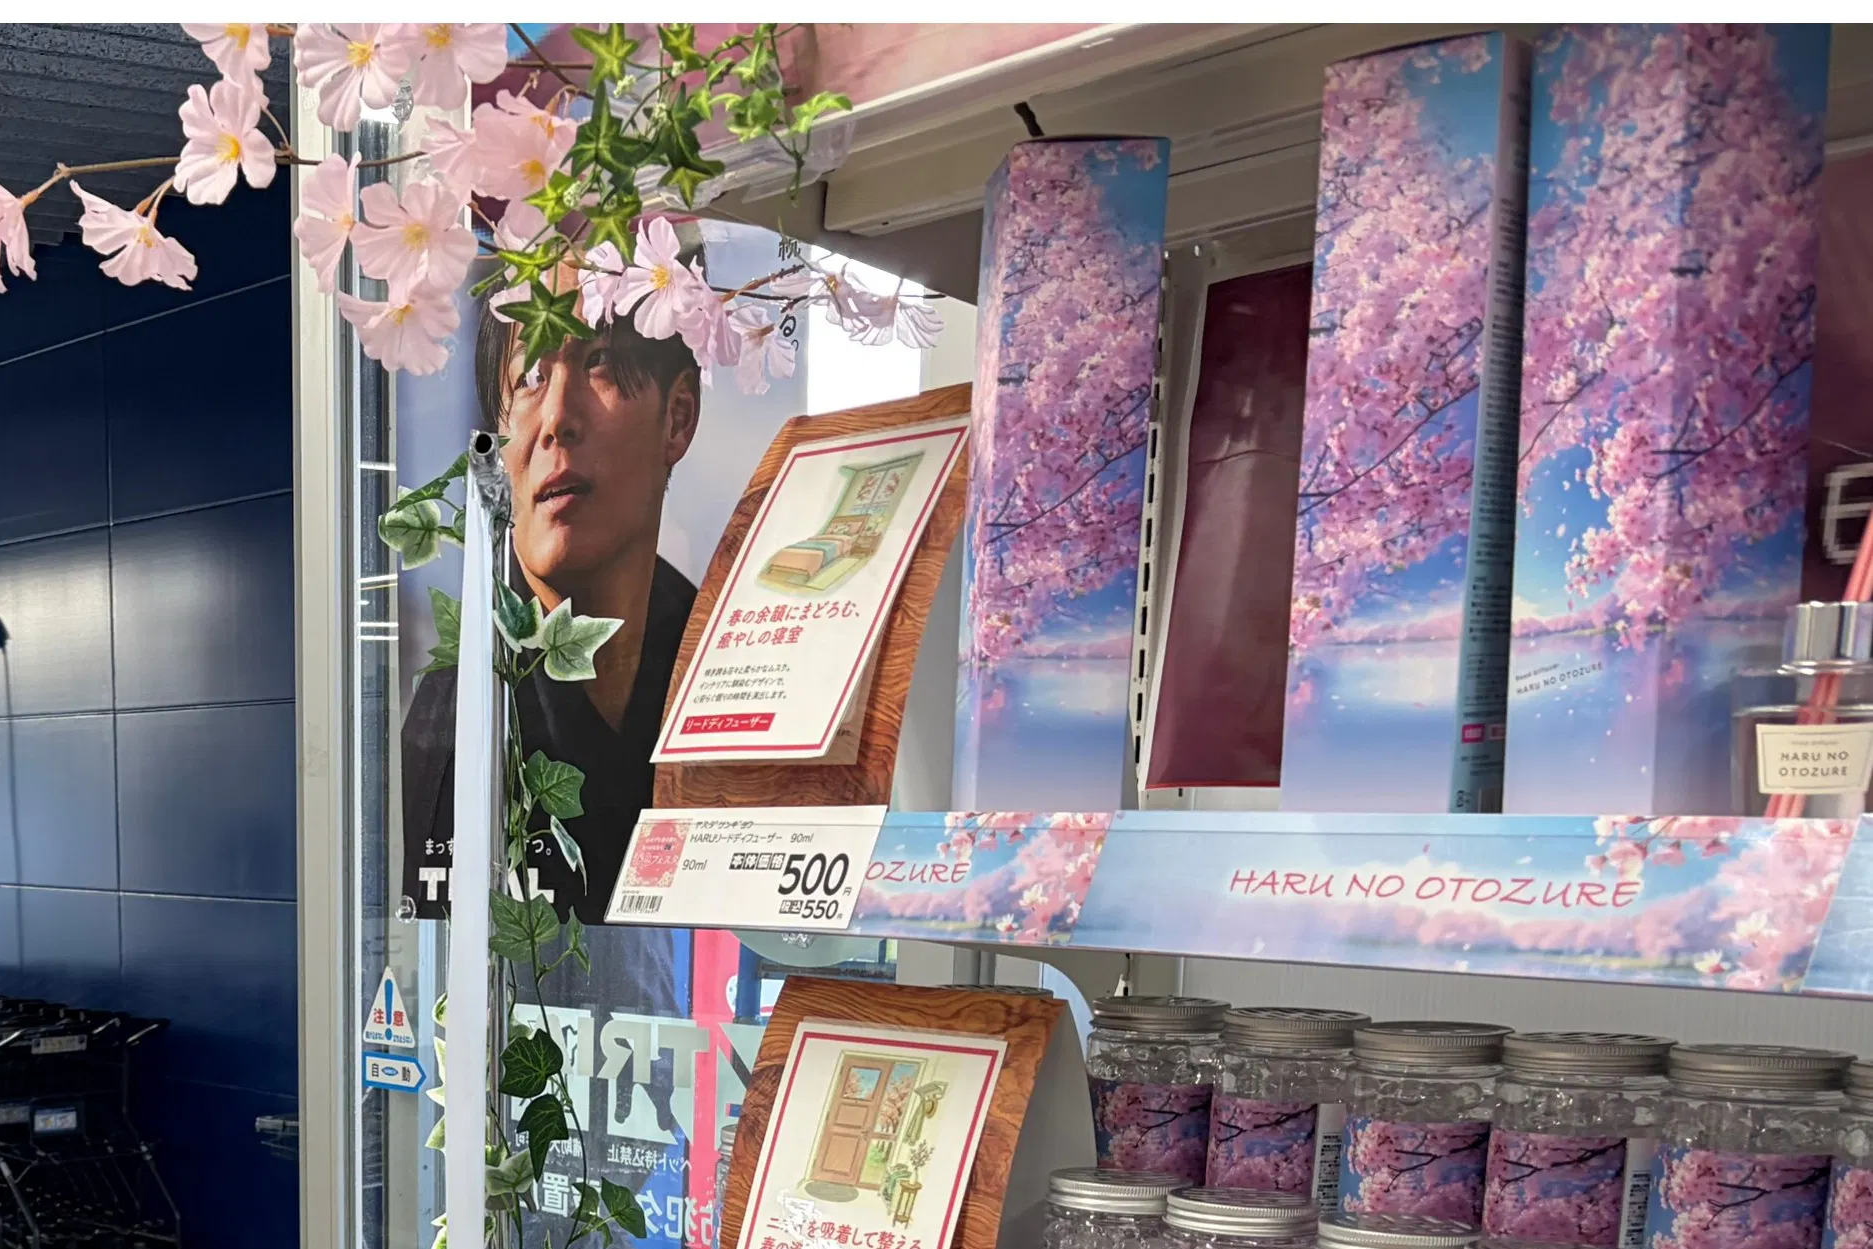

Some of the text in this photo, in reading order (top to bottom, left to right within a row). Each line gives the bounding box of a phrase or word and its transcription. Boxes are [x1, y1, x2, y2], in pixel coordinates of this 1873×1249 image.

[726, 600, 861, 627] 春の余韻にまどろむ、
[715, 625, 805, 650] 癒やしの寝室
[1516, 662, 1604, 695] HARU NO OTOZURE
[685, 717, 769, 731] リードディフューザー
[1781, 751, 1849, 763] HARU NO
[1779, 766, 1848, 778] OTOZURE
[790, 833, 814, 844] 90ml
[682, 858, 708, 871] 90ml
[1229, 868, 1642, 911] HARU NO OTOZURE
